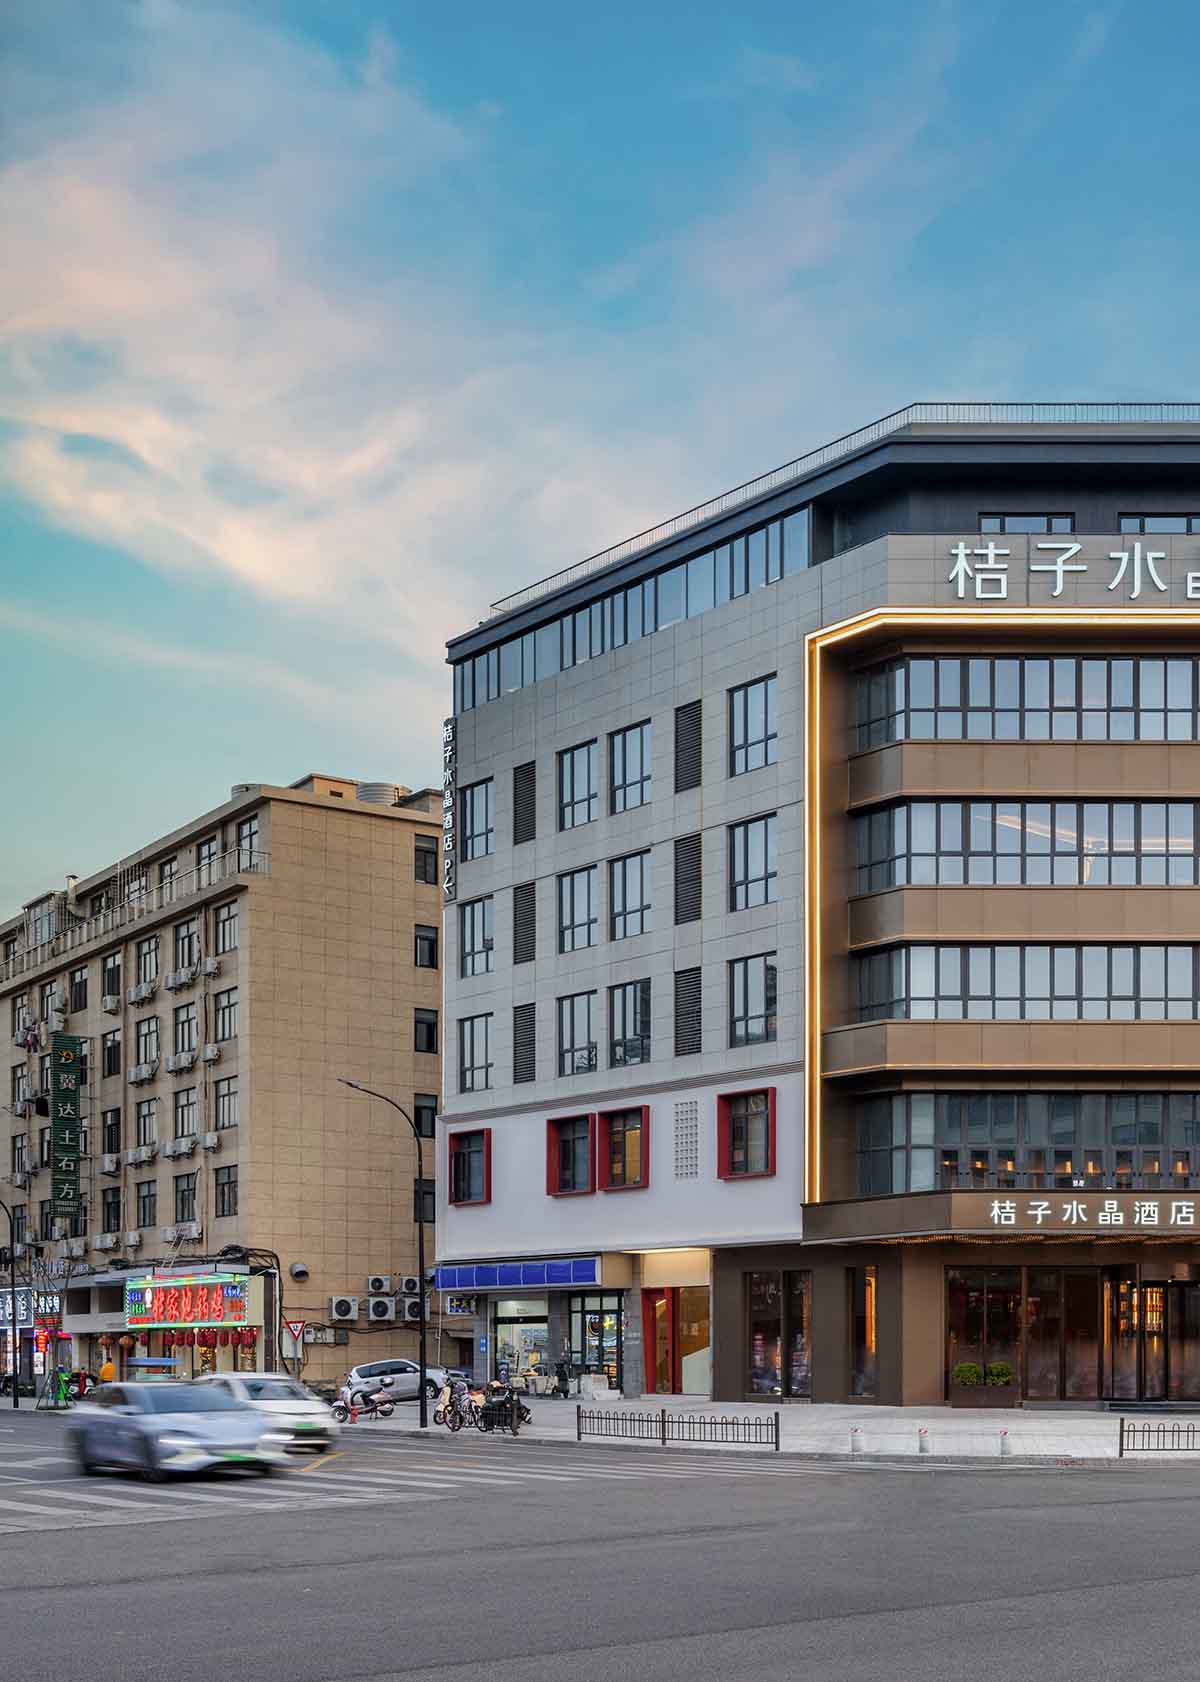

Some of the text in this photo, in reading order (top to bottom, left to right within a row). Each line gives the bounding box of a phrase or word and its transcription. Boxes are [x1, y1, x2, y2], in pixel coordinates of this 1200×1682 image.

[443, 725, 453, 850] 桔子水晶酒店
[444, 860, 451, 875] P
[990, 1200, 1196, 1226] 桔子水晶酒店
